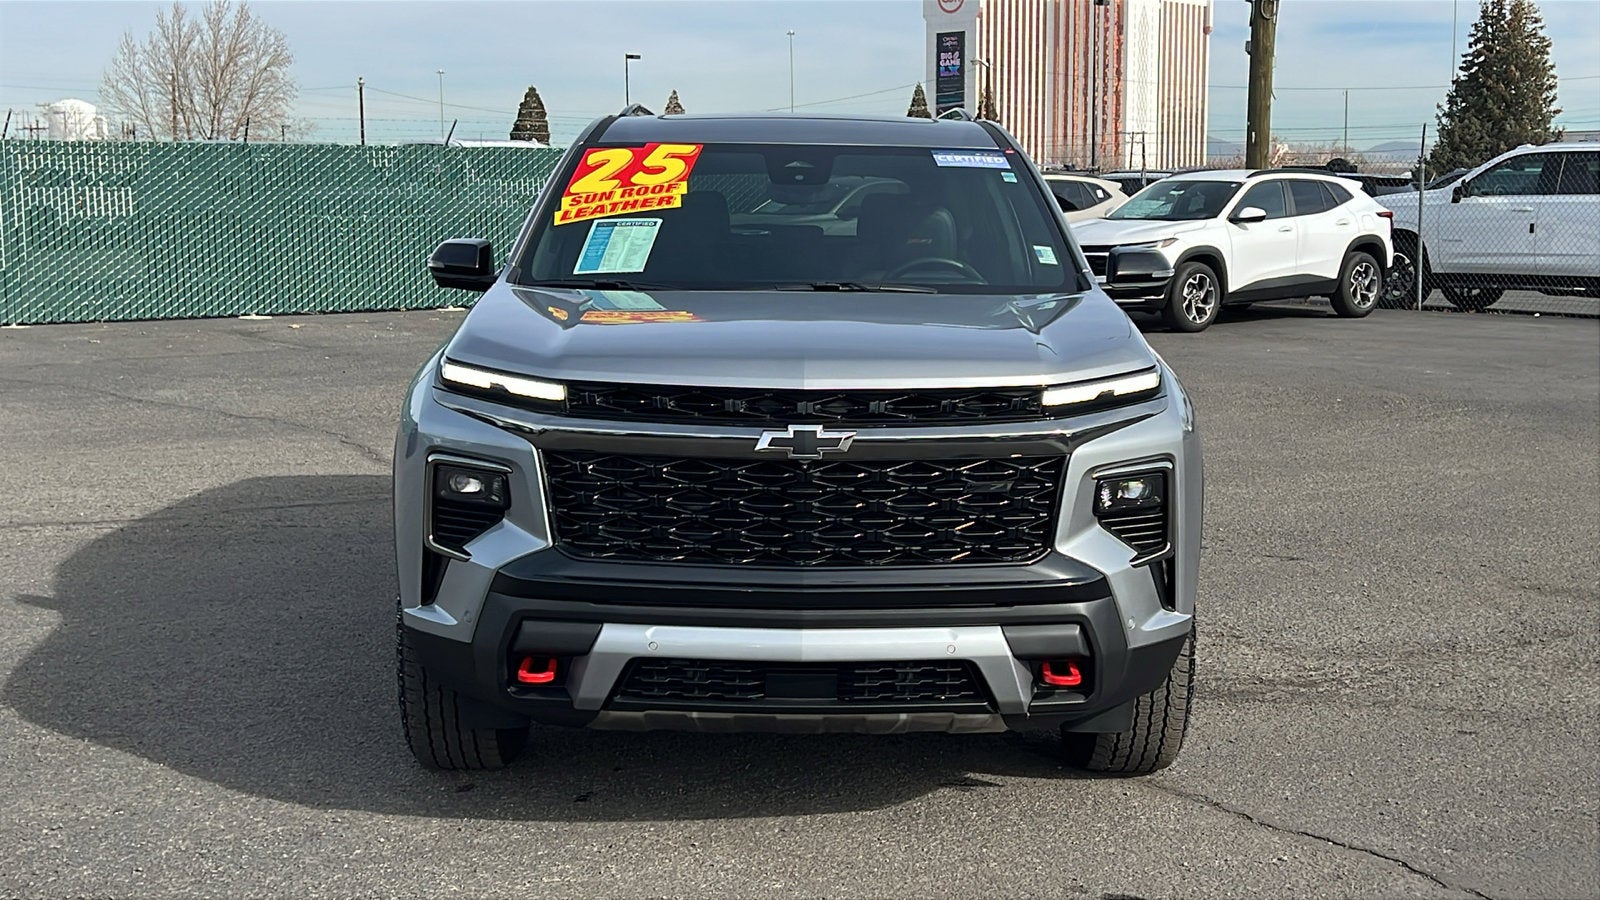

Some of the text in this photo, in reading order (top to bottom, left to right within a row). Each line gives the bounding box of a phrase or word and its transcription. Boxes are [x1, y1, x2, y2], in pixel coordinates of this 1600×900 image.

[940, 52, 953, 60] BIG
[939, 59, 961, 67] GAME
[937, 154, 1005, 165] CERTIFIED
[569, 143, 699, 194] 25
[568, 182, 682, 207] SUN ROOF
[559, 195, 675, 222] LEATHER
[616, 220, 655, 228] CERTIFIED
